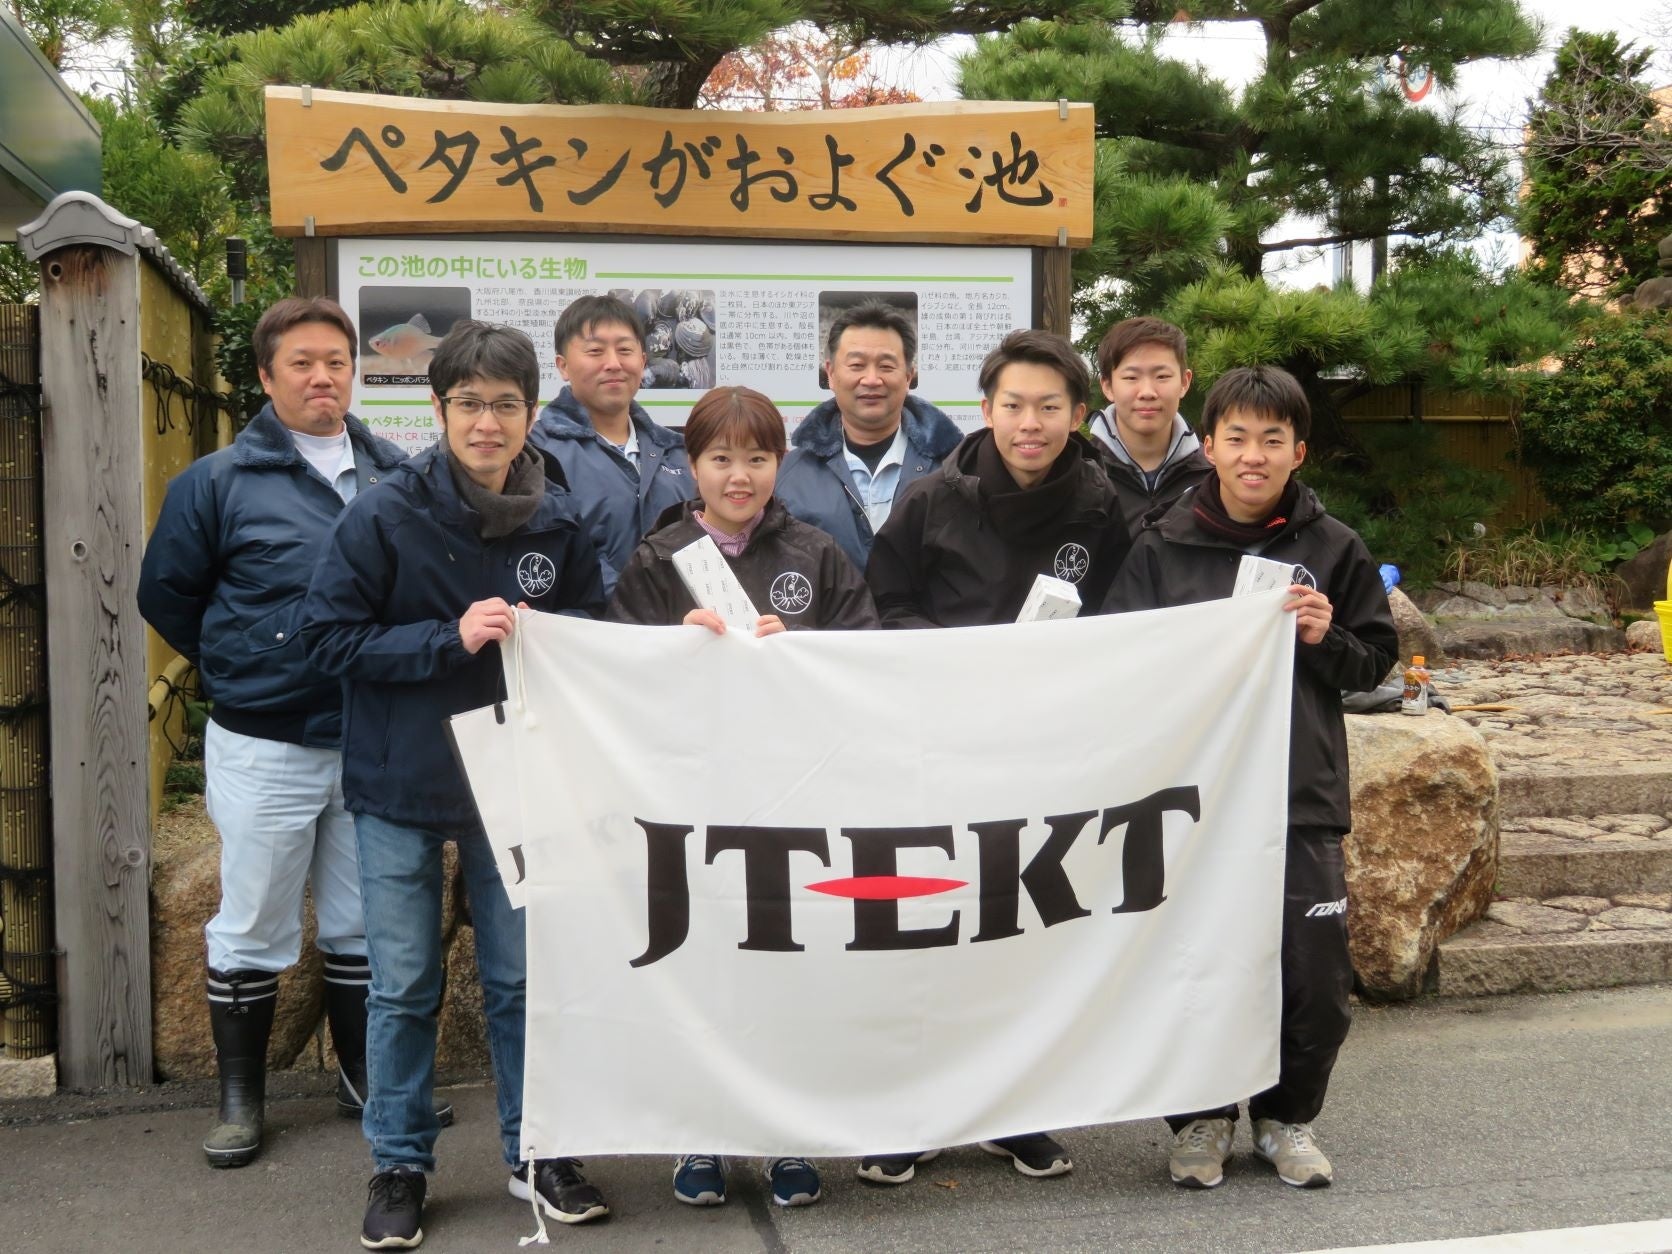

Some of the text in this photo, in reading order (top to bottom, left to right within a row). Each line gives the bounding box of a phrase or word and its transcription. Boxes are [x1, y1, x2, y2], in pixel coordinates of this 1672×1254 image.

[320, 125, 1054, 216] ペタキンがおよぐ池
[358, 255, 588, 280] この池の中にいる生物
[372, 415, 434, 428] ペタキンとは
[629, 786, 1202, 968] JTEKT
